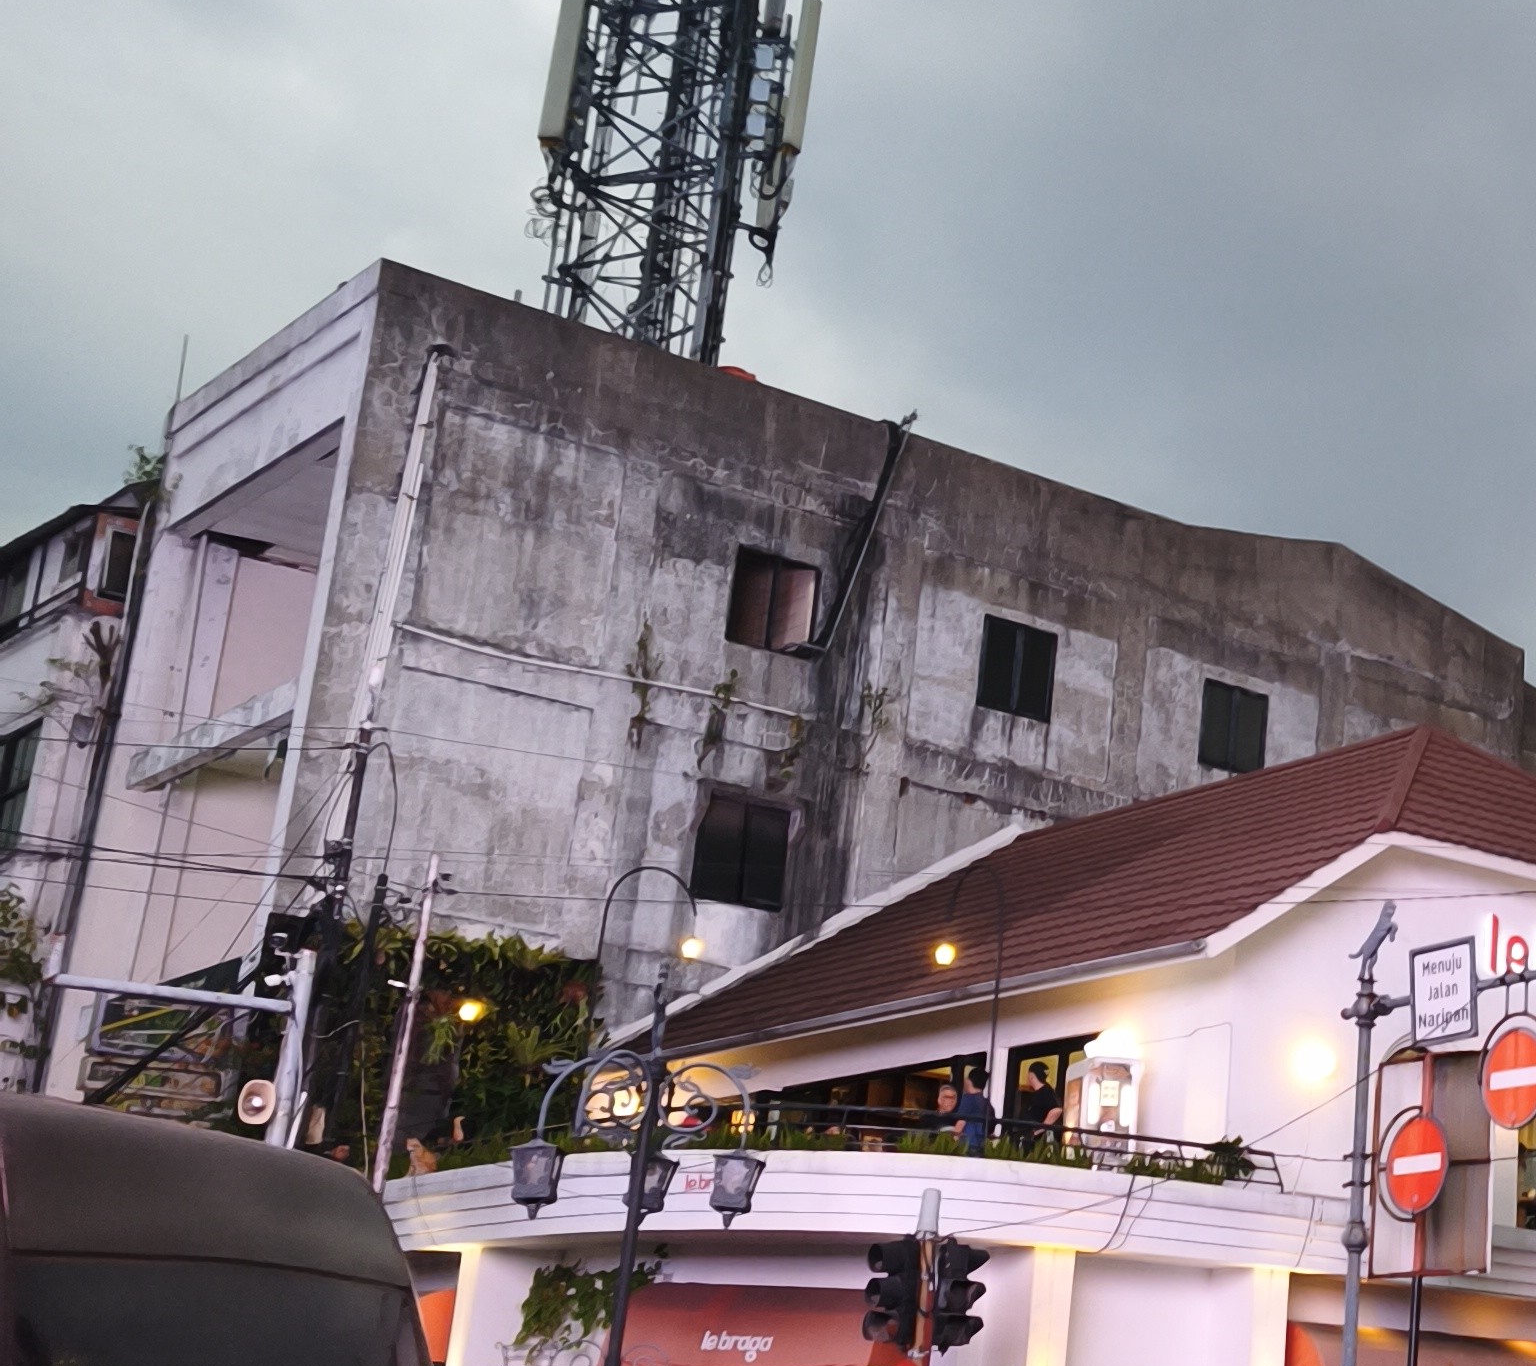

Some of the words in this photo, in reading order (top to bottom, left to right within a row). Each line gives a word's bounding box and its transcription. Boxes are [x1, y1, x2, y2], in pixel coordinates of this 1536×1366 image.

[1422, 952, 1463, 978] Menuju
[1428, 981, 1459, 1002] Jalan
[1418, 1007, 1469, 1033] Naripan
